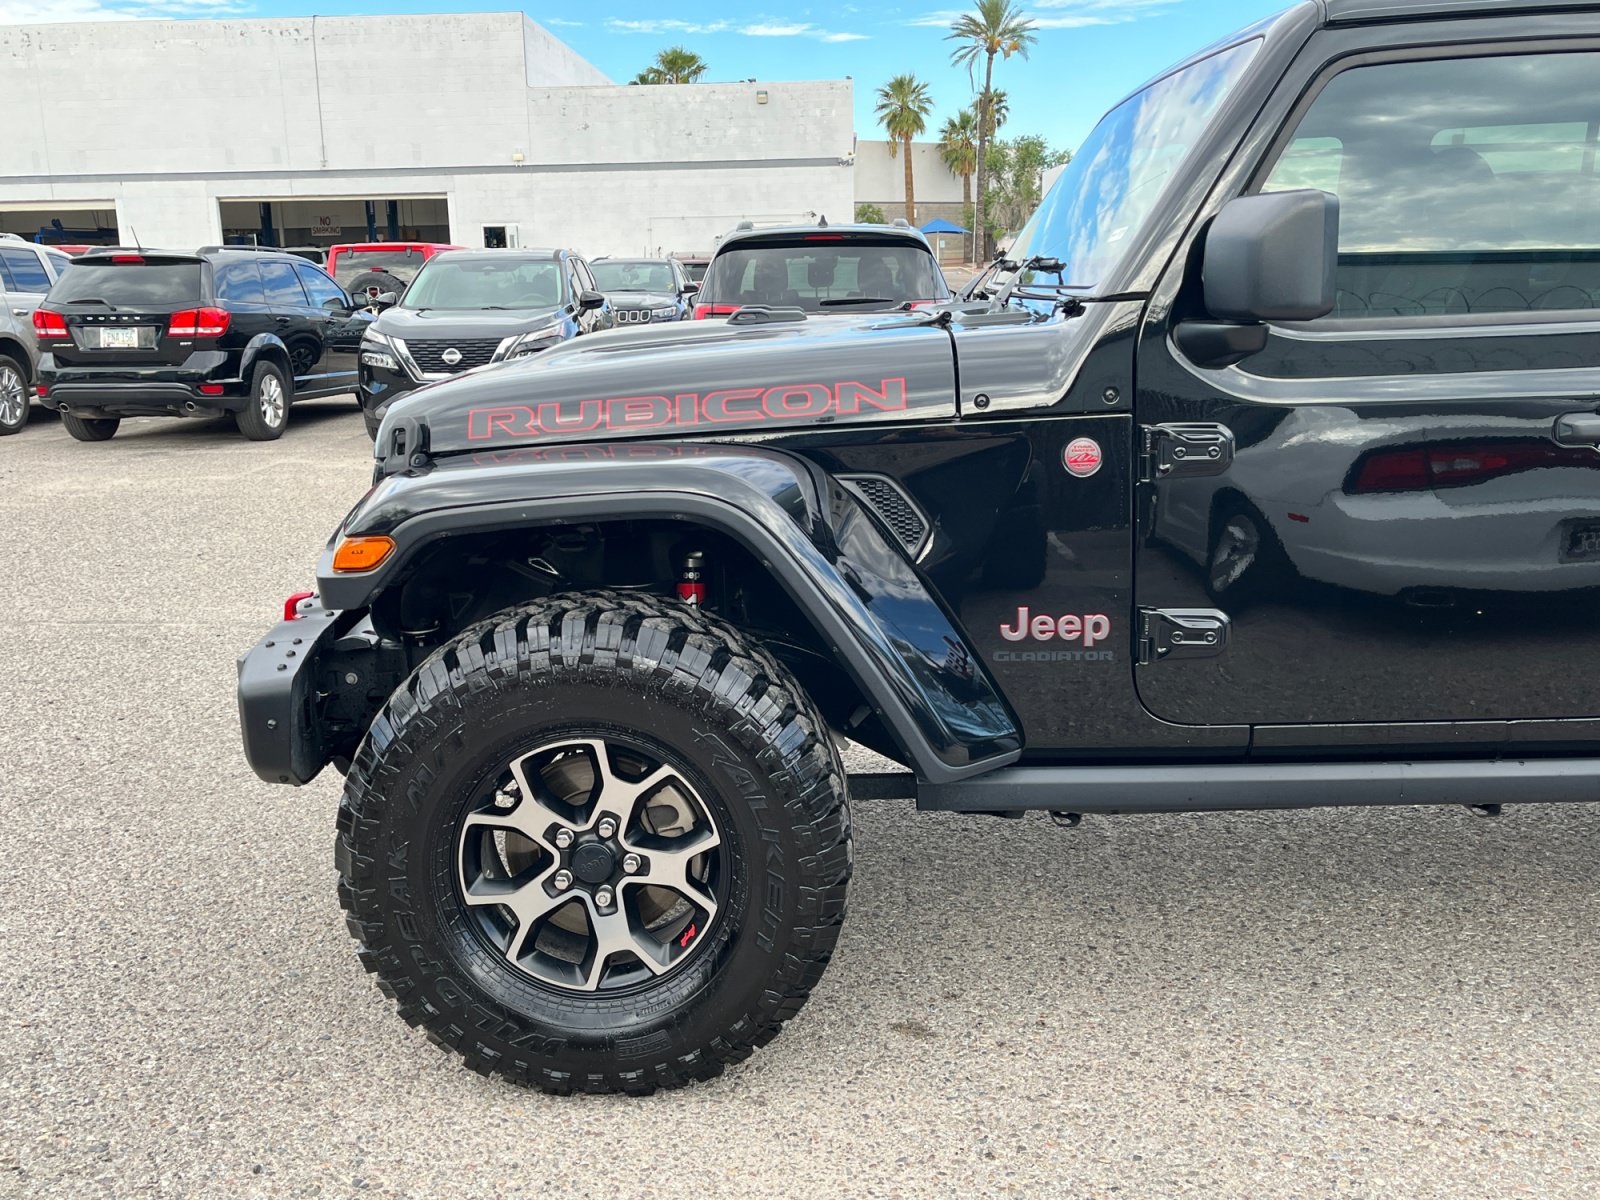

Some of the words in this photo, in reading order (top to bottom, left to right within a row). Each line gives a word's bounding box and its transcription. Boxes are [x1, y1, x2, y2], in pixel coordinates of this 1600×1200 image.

[319, 215, 331, 226] NO
[312, 225, 340, 235] SMOKING
[468, 377, 907, 440] RUBICON
[682, 571, 701, 581] eep
[1000, 606, 1111, 648] Jeep
[992, 650, 1114, 662] GLADIATOR
[387, 834, 568, 1054] WILDPEAK
